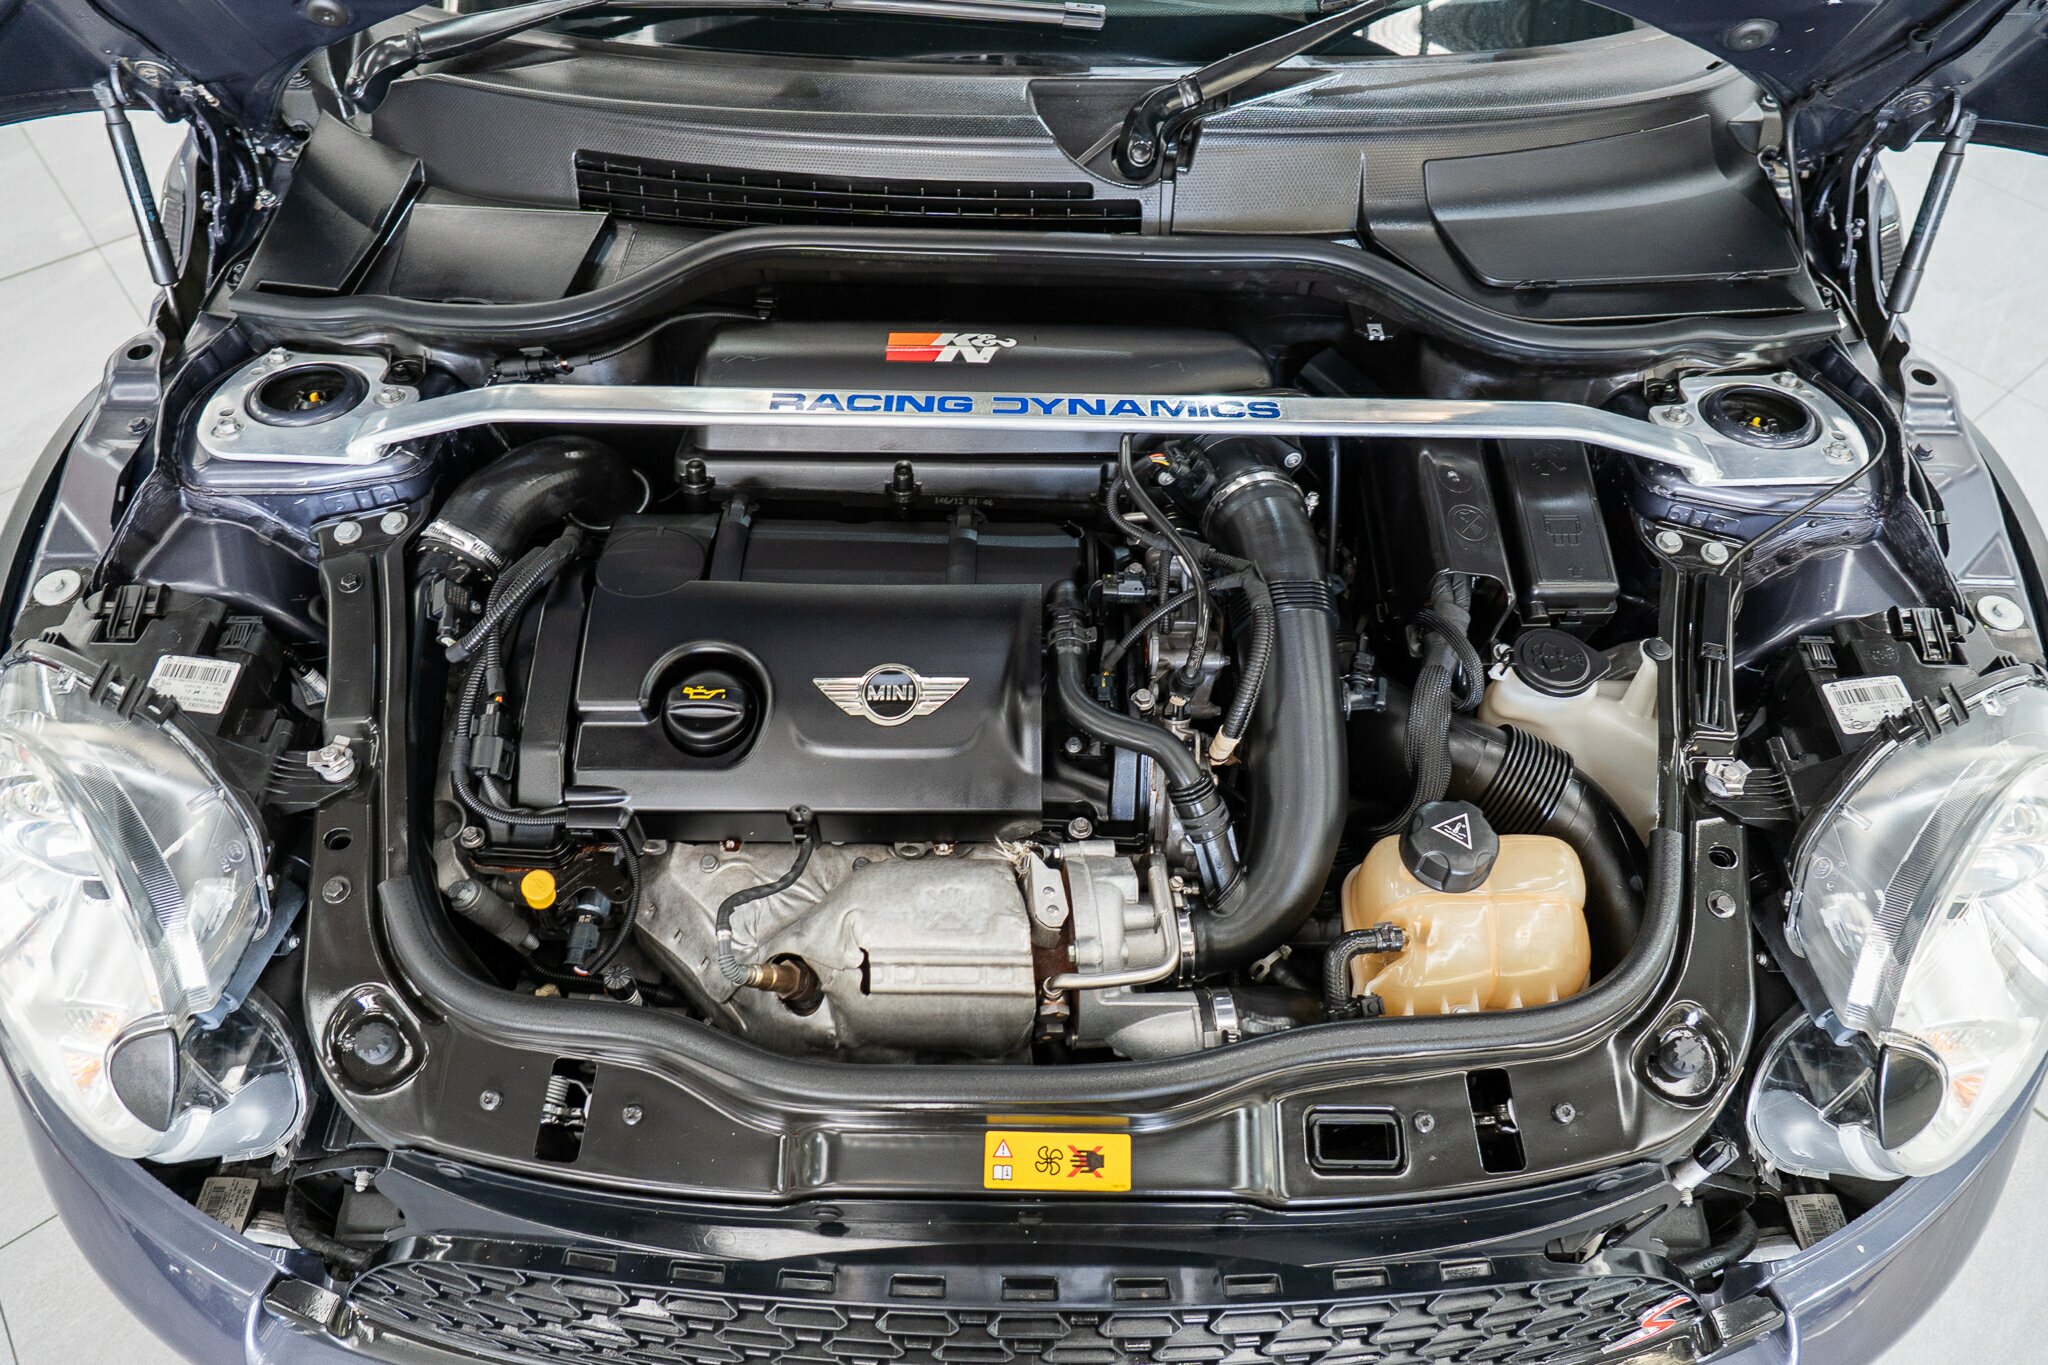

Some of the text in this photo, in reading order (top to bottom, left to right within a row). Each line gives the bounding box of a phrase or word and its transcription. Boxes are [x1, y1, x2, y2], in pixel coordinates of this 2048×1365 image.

[769, 393, 1281, 419] RACING DYNAMICS
[867, 684, 914, 701] MINI
